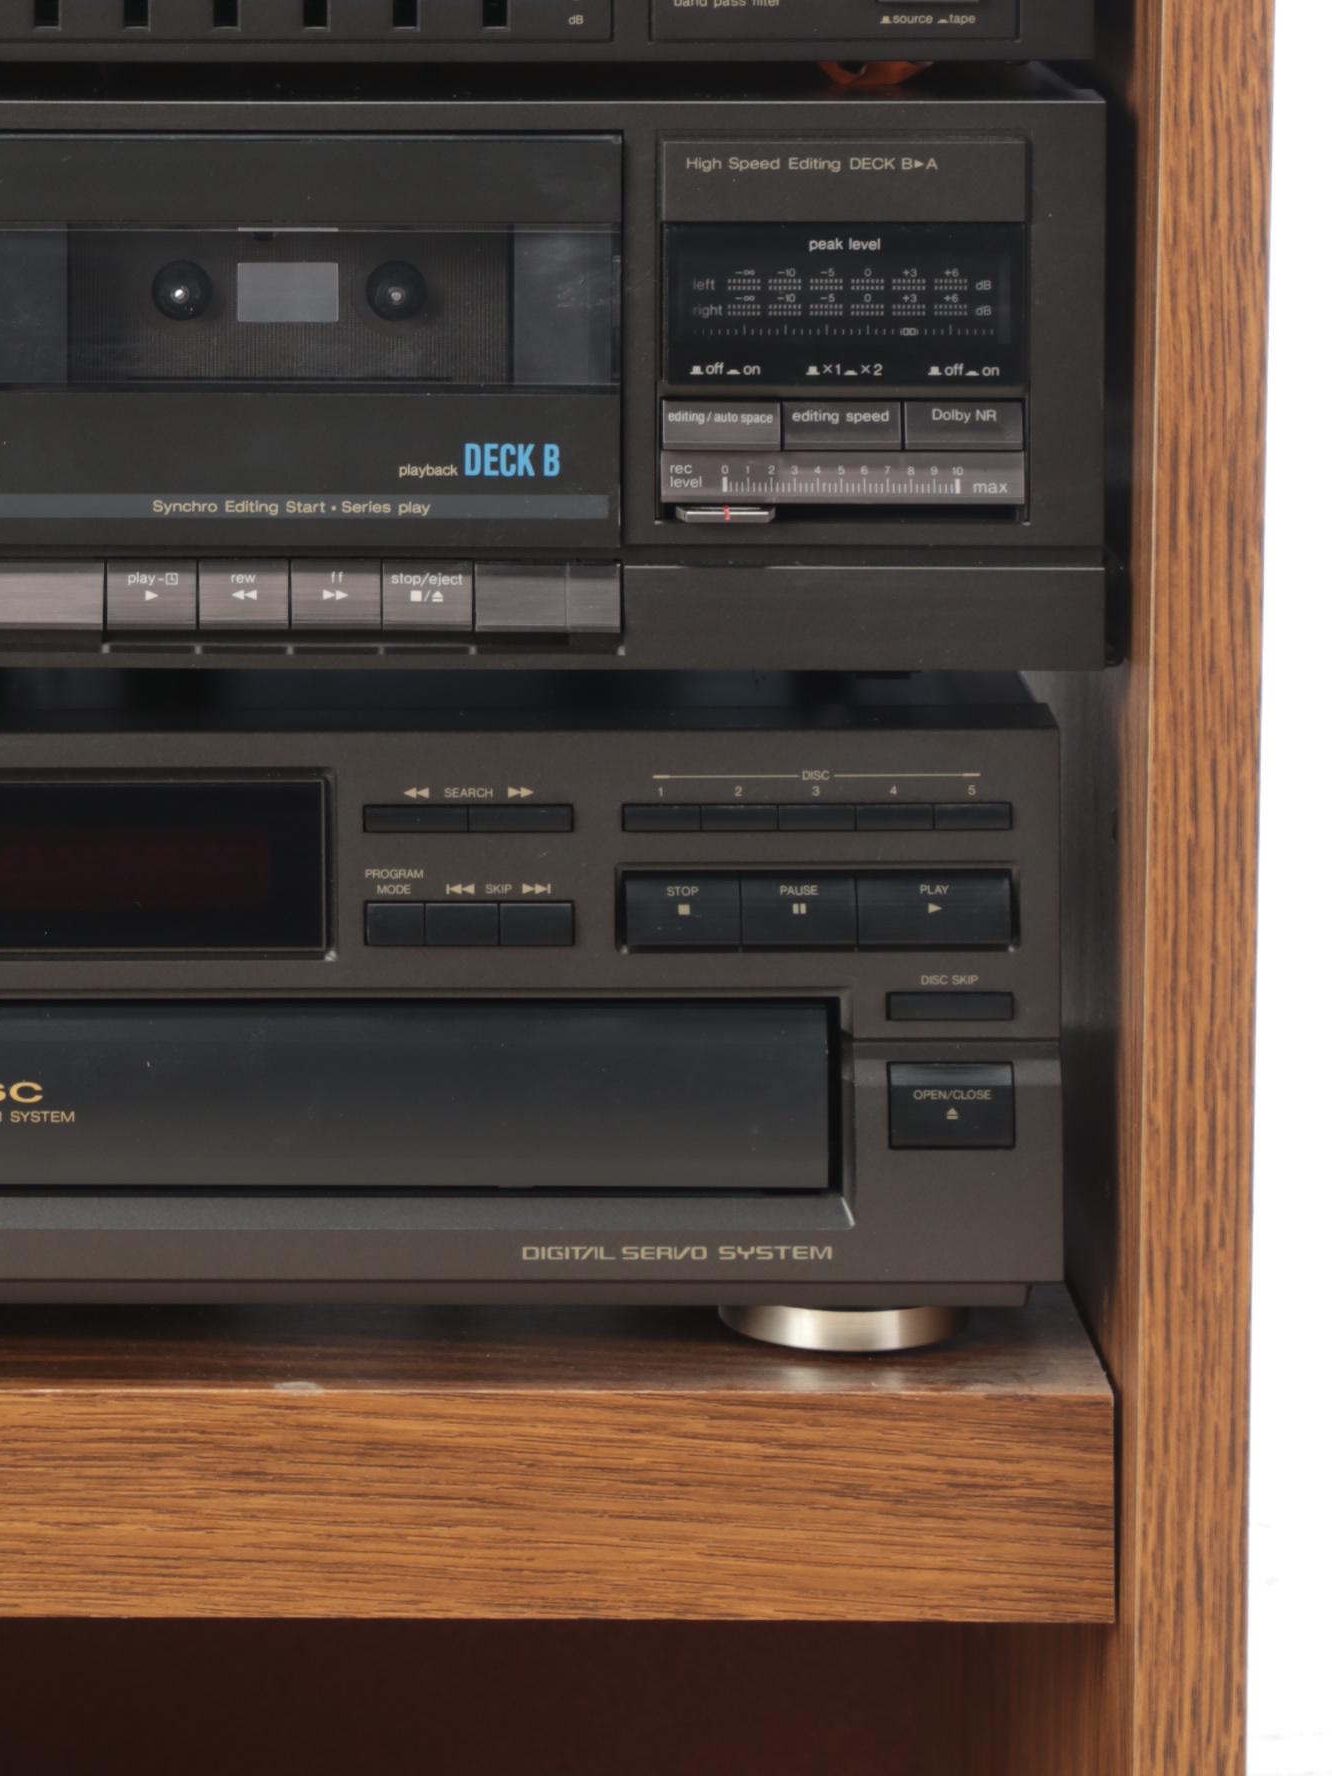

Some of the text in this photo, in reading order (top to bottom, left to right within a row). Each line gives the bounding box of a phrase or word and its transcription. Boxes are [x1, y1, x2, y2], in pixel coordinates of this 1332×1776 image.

[686, 156, 895, 173] High Speed Editing DECK
[808, 237, 881, 252] peak level
[791, 409, 890, 425] editing speed
[931, 407, 997, 424] Dolby NR
[398, 443, 560, 479] playback DECK B
[152, 499, 431, 517] Synchro Editing Start Series play
[391, 572, 463, 587] stop/eject
[444, 787, 494, 799] SEARCH
[485, 883, 513, 895] SKIP
[666, 885, 699, 897] STOP
[779, 884, 819, 897] PAUSE
[919, 884, 949, 896] PLAY
[912, 1089, 992, 1101] OPEN/CLOSE
[10, 1110, 76, 1123] SYSTEM
[522, 1245, 833, 1261] DIGITAL SERVO SYSTEM
